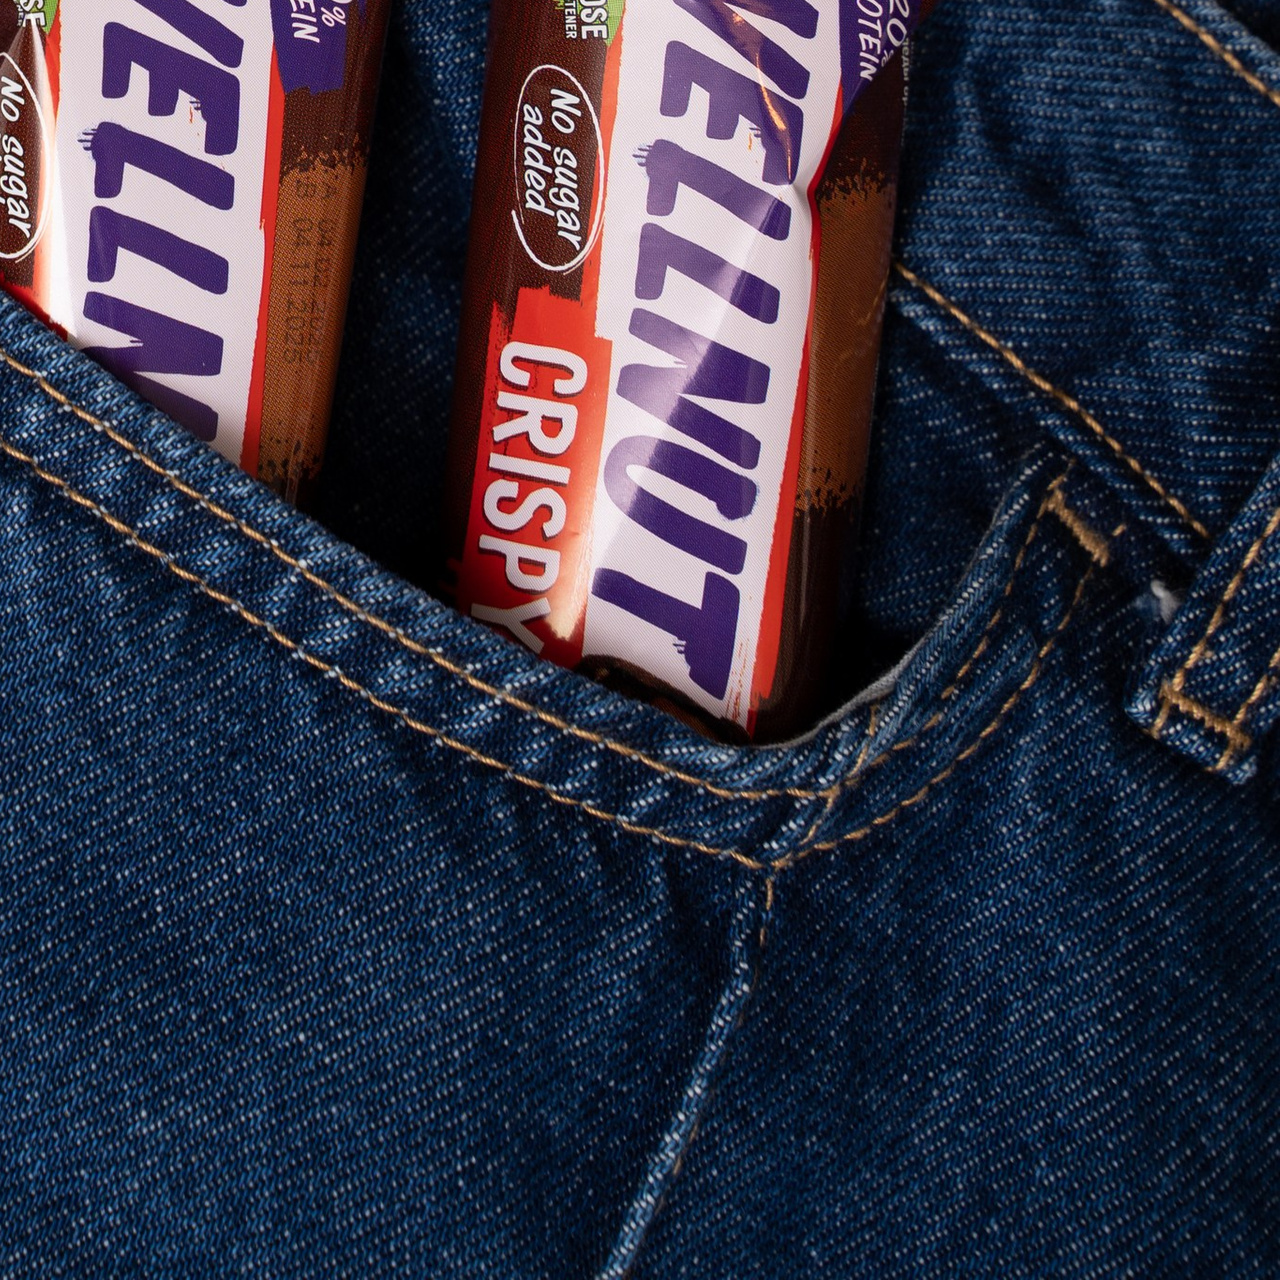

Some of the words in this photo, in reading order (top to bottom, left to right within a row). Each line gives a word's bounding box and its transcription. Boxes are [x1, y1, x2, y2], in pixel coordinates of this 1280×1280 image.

[0, 75, 25, 123] No
[550, 89, 582, 134] No
[0, 134, 31, 238] sugar
[523, 103, 555, 217] added
[549, 146, 582, 251] sugar
[470, 341, 588, 654] CRISPY
